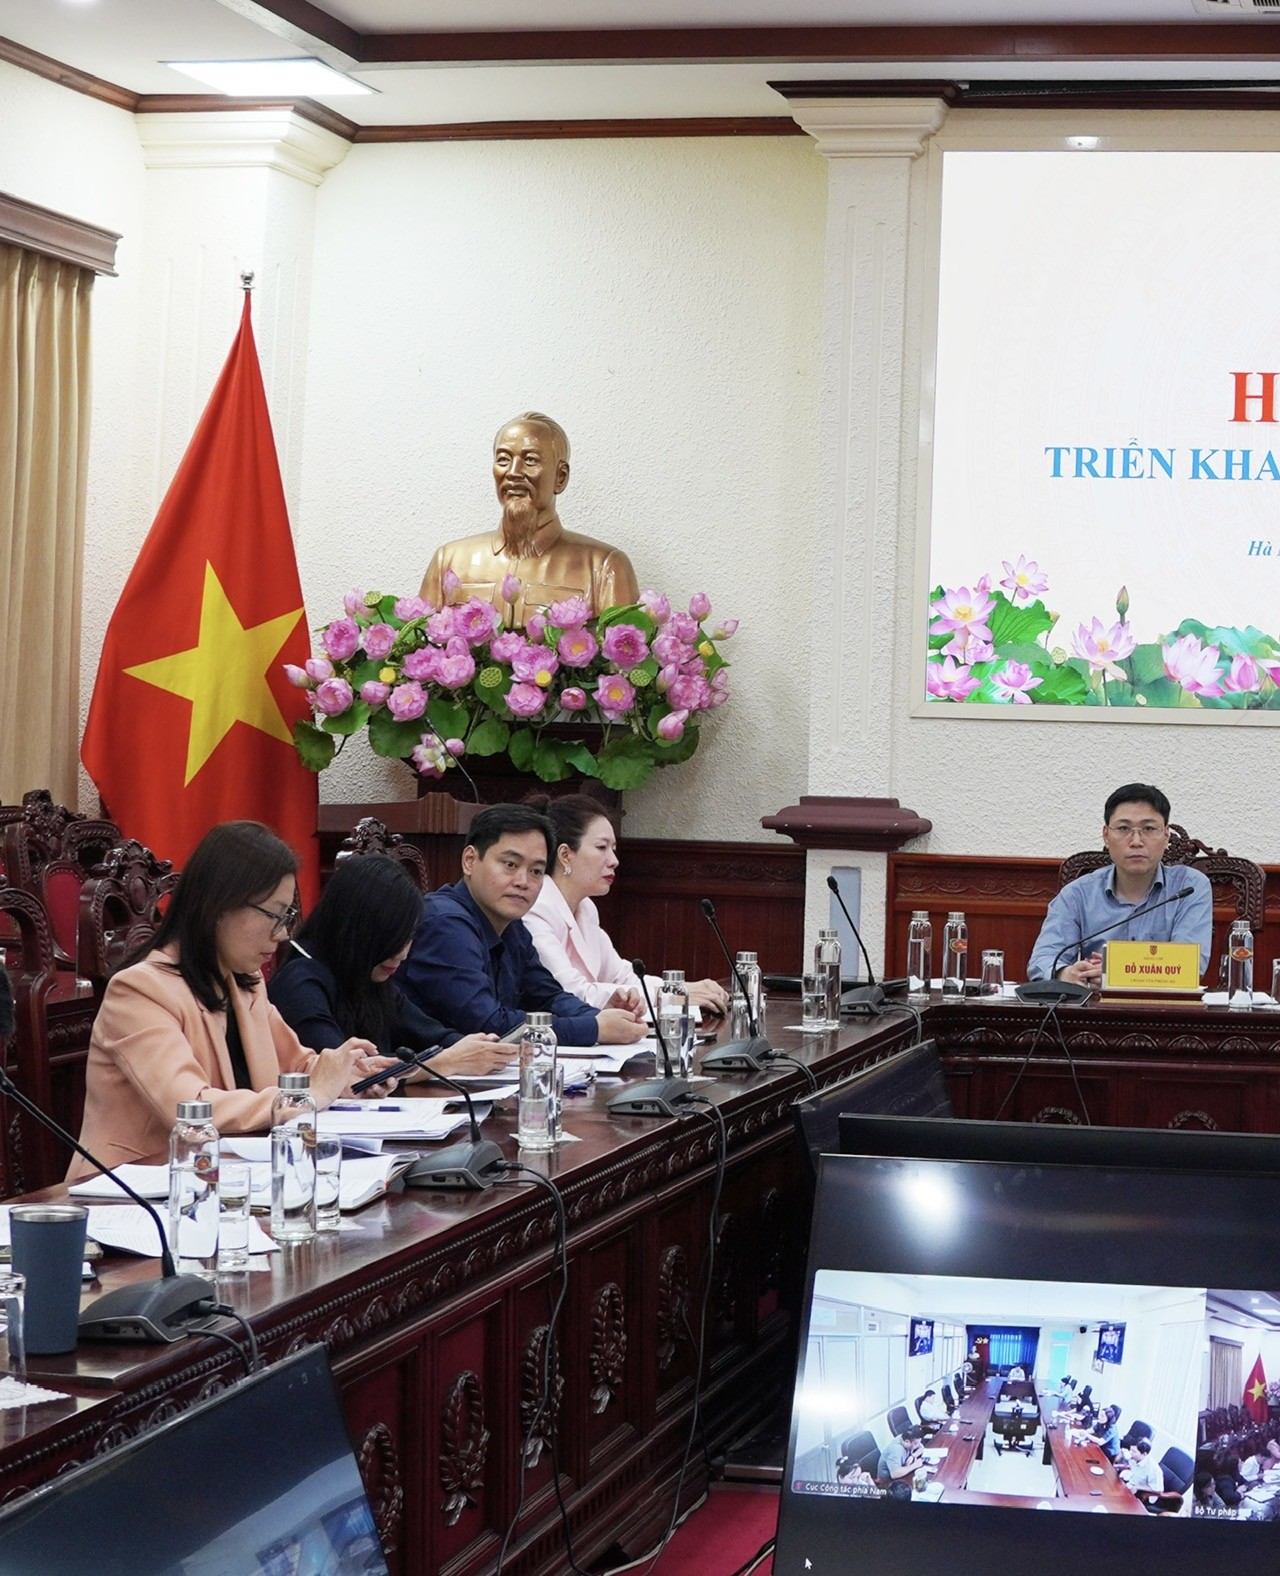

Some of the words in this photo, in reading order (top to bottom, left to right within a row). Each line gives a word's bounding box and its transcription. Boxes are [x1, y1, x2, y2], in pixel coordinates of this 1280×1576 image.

[1045, 438, 1176, 480] TRIỂN
[1248, 540, 1272, 557] Hà
[1139, 964, 1163, 975] XUÂN
[1165, 964, 1182, 975] QUÝ
